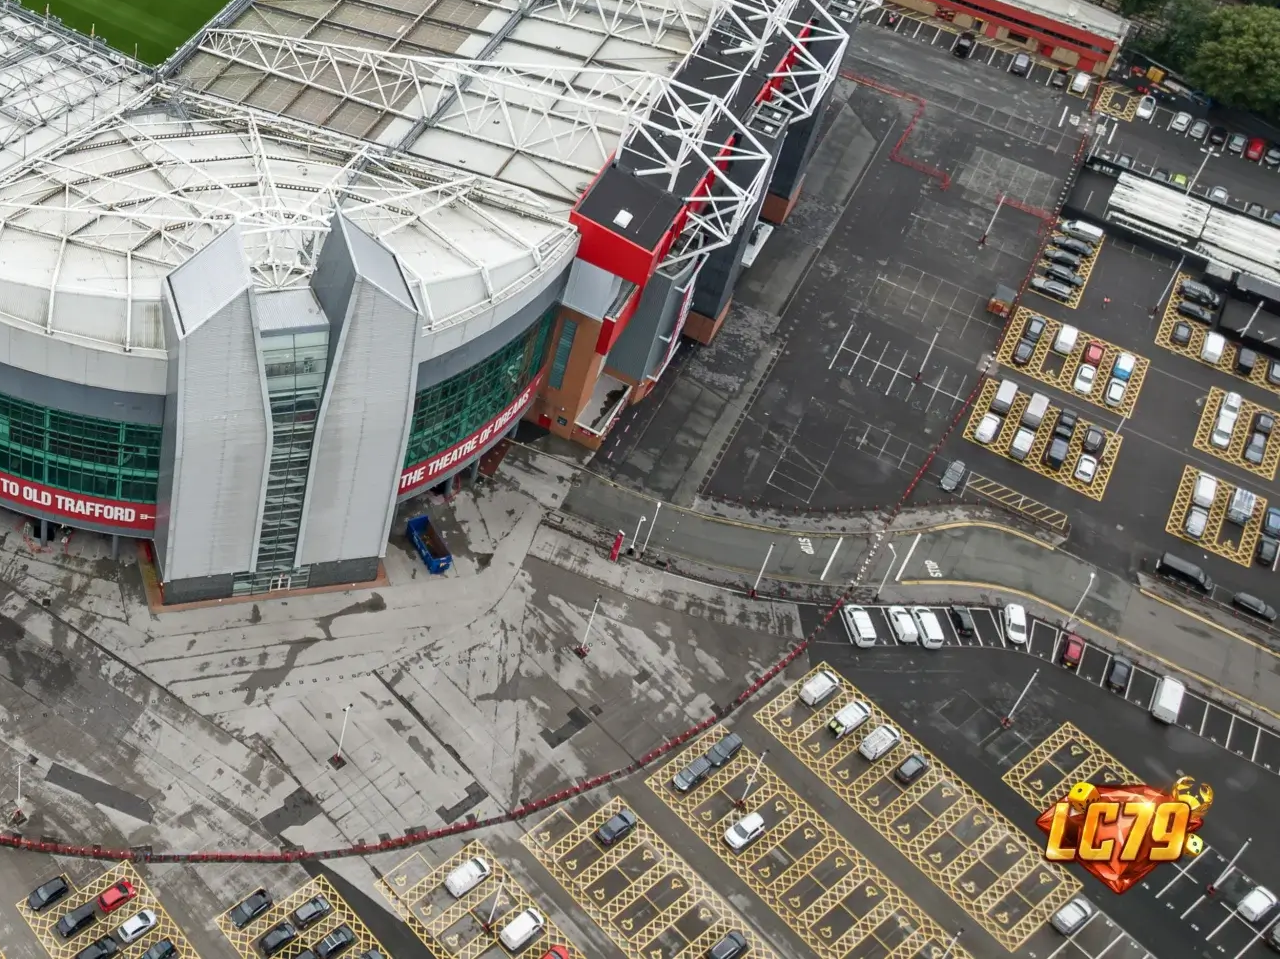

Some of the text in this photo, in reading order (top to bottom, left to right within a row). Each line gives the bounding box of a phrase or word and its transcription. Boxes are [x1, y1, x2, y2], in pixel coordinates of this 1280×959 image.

[400, 466, 426, 488] THE
[428, 435, 479, 475] THEATRE
[479, 425, 494, 444] OF
[0, 478, 19, 497] TO
[22, 486, 52, 506] OLD
[55, 494, 135, 522] TRAFFORD
[798, 537, 815, 555] STOP
[924, 559, 942, 577] STOP
